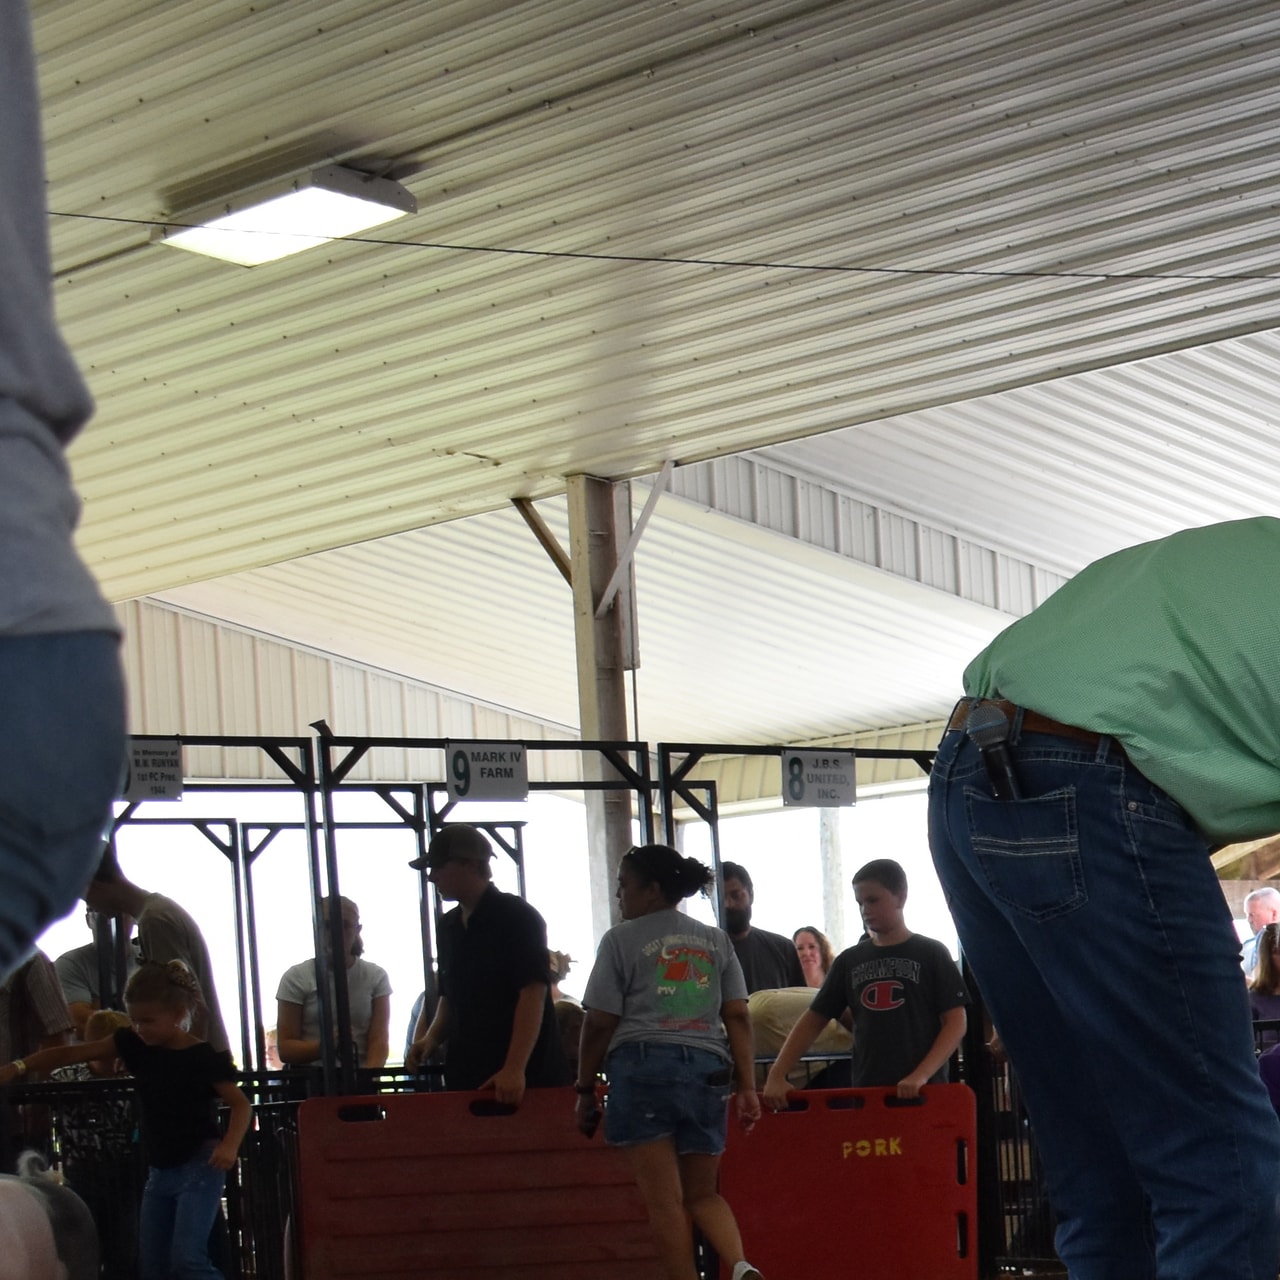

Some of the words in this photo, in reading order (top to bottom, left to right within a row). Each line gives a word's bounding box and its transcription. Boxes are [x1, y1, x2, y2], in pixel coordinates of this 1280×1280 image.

[471, 752, 506, 762] MARK
[510, 752, 521, 762] IV
[812, 759, 842, 769] J.B.S.
[453, 750, 470, 796] 9
[480, 767, 514, 778] FARM
[789, 757, 804, 801] 8
[807, 773, 850, 787] UNITED,
[817, 789, 840, 799] INC.
[842, 1137, 902, 1159] PORK
